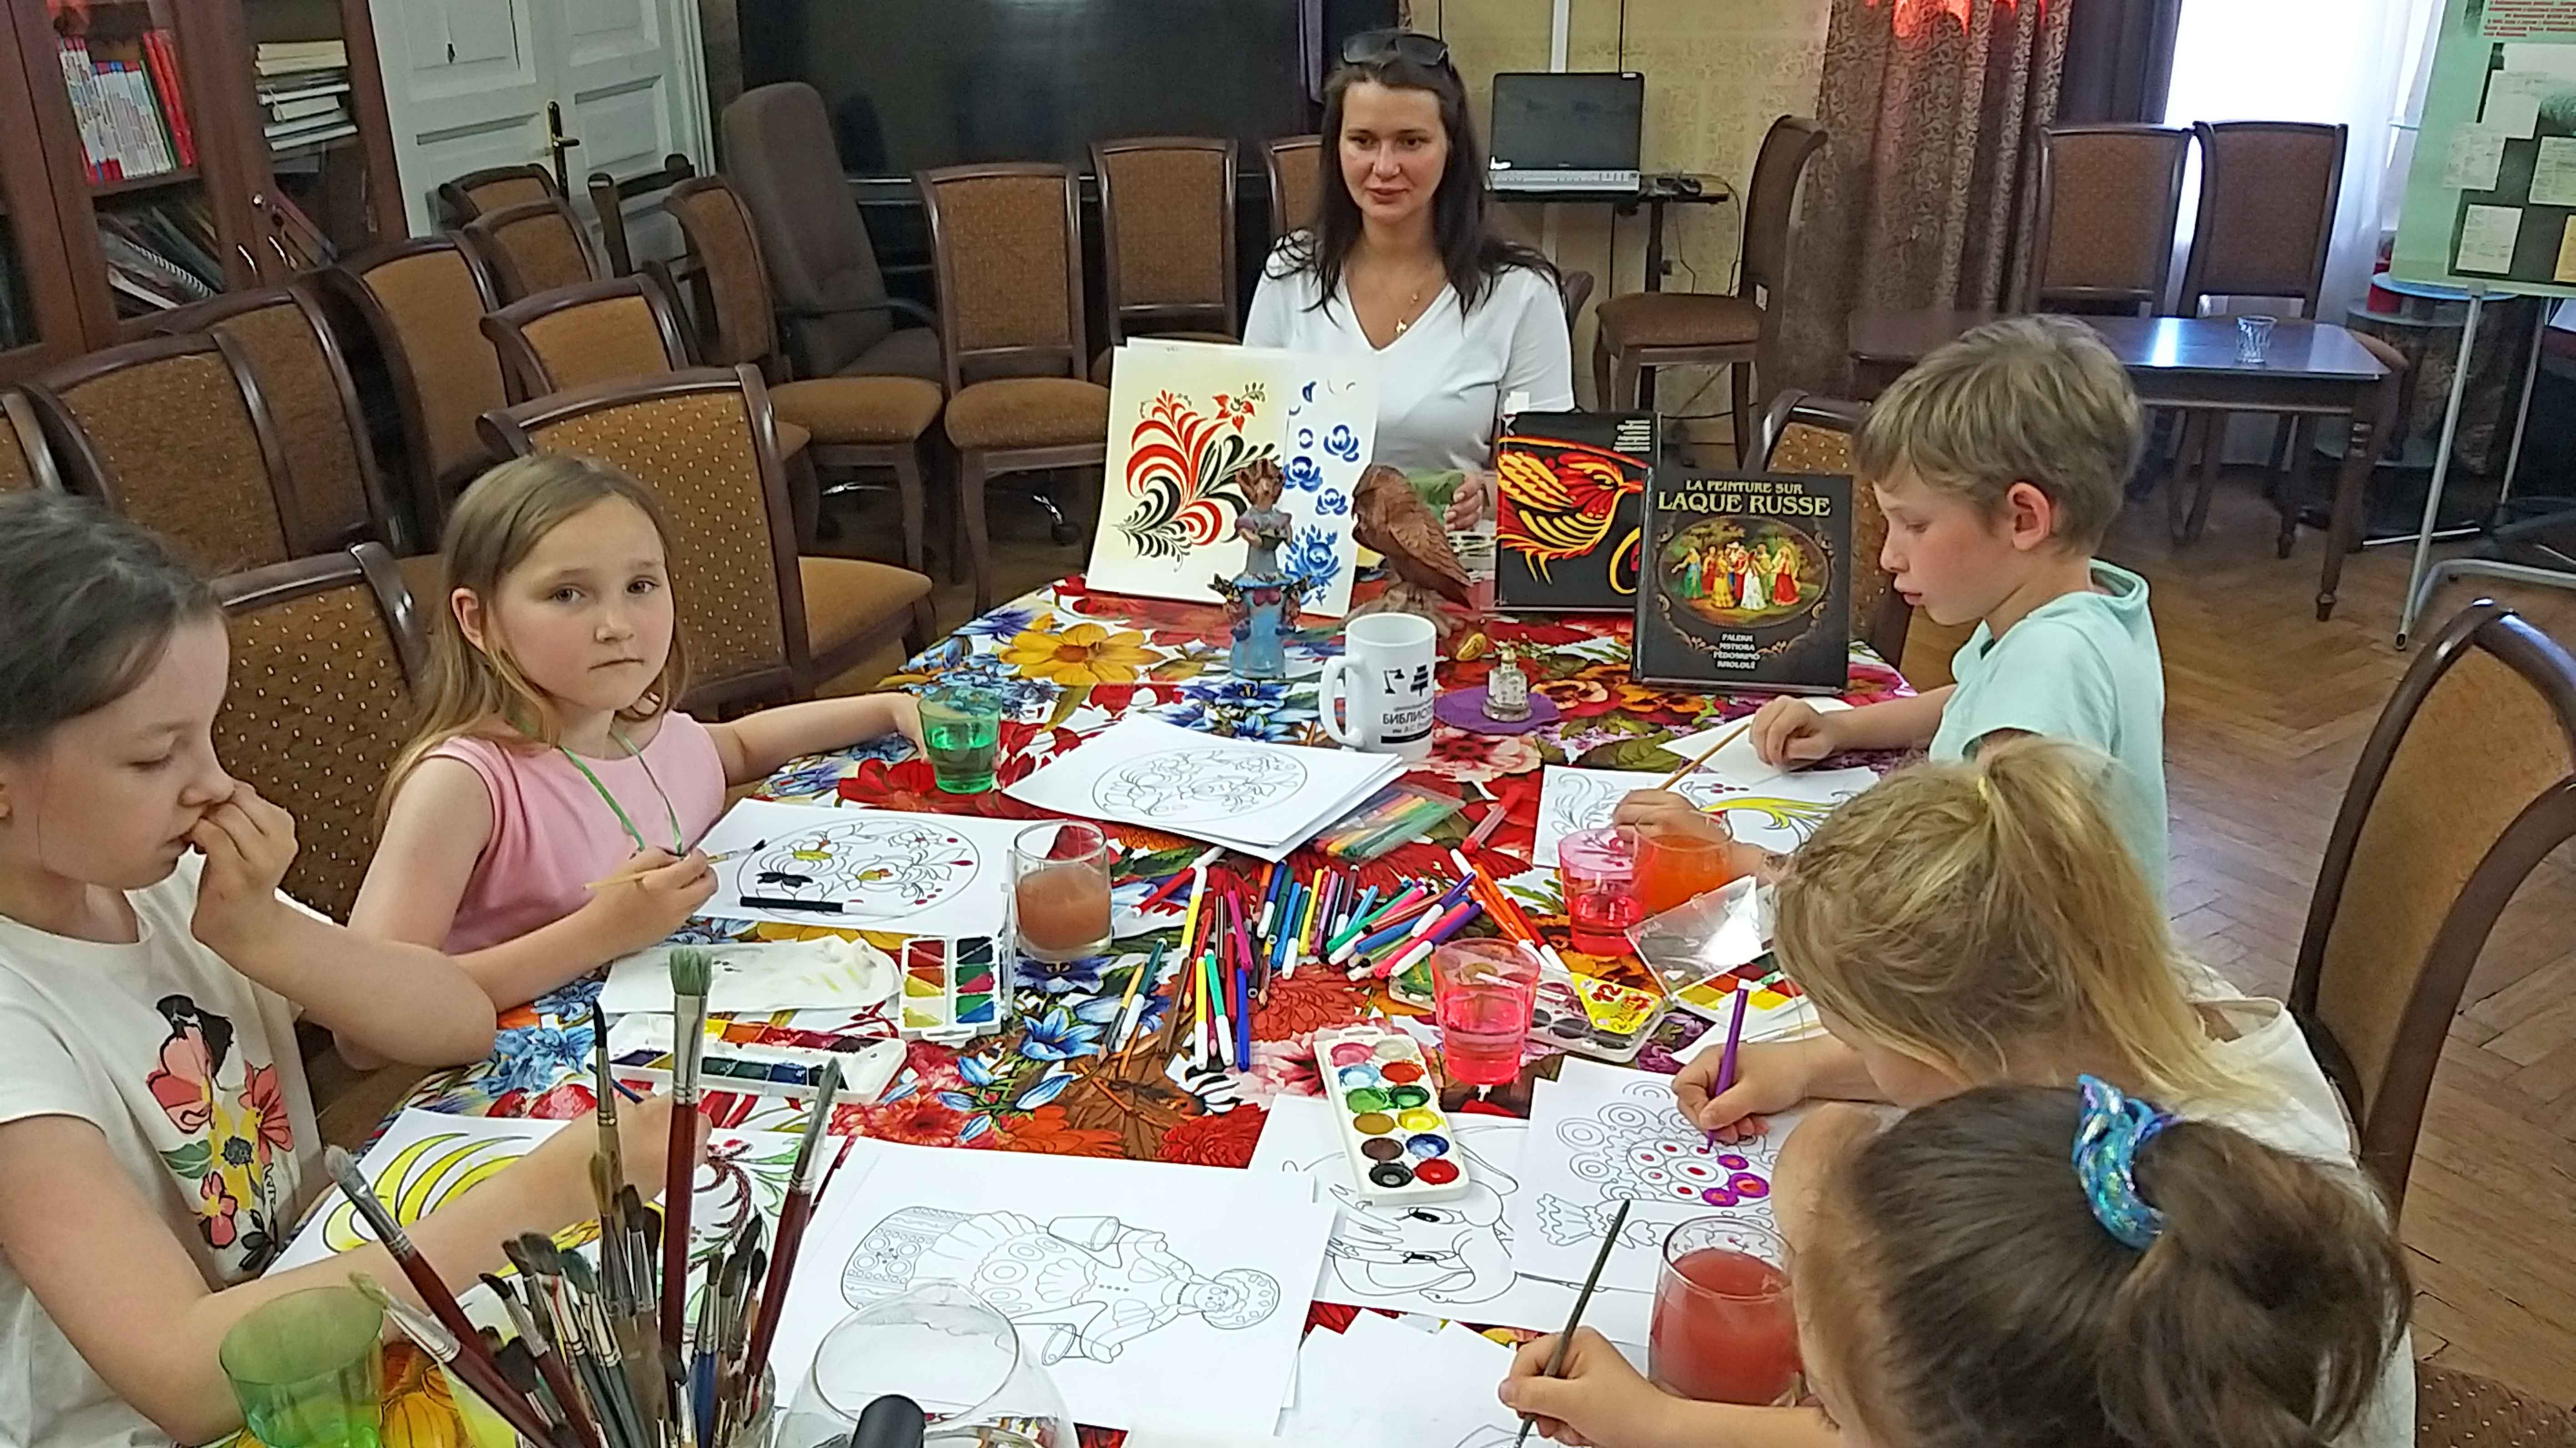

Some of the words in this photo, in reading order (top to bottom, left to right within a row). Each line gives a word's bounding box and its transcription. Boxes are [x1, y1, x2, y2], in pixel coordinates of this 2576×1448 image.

[1685, 480, 1703, 491] LA
[1707, 480, 1772, 493] PEINTURE
[1775, 483, 1803, 495] SUR
[1658, 491, 1743, 513] LAQUE
[1750, 495, 1831, 516] RUSSE
[1591, 984, 1623, 1002] 12
